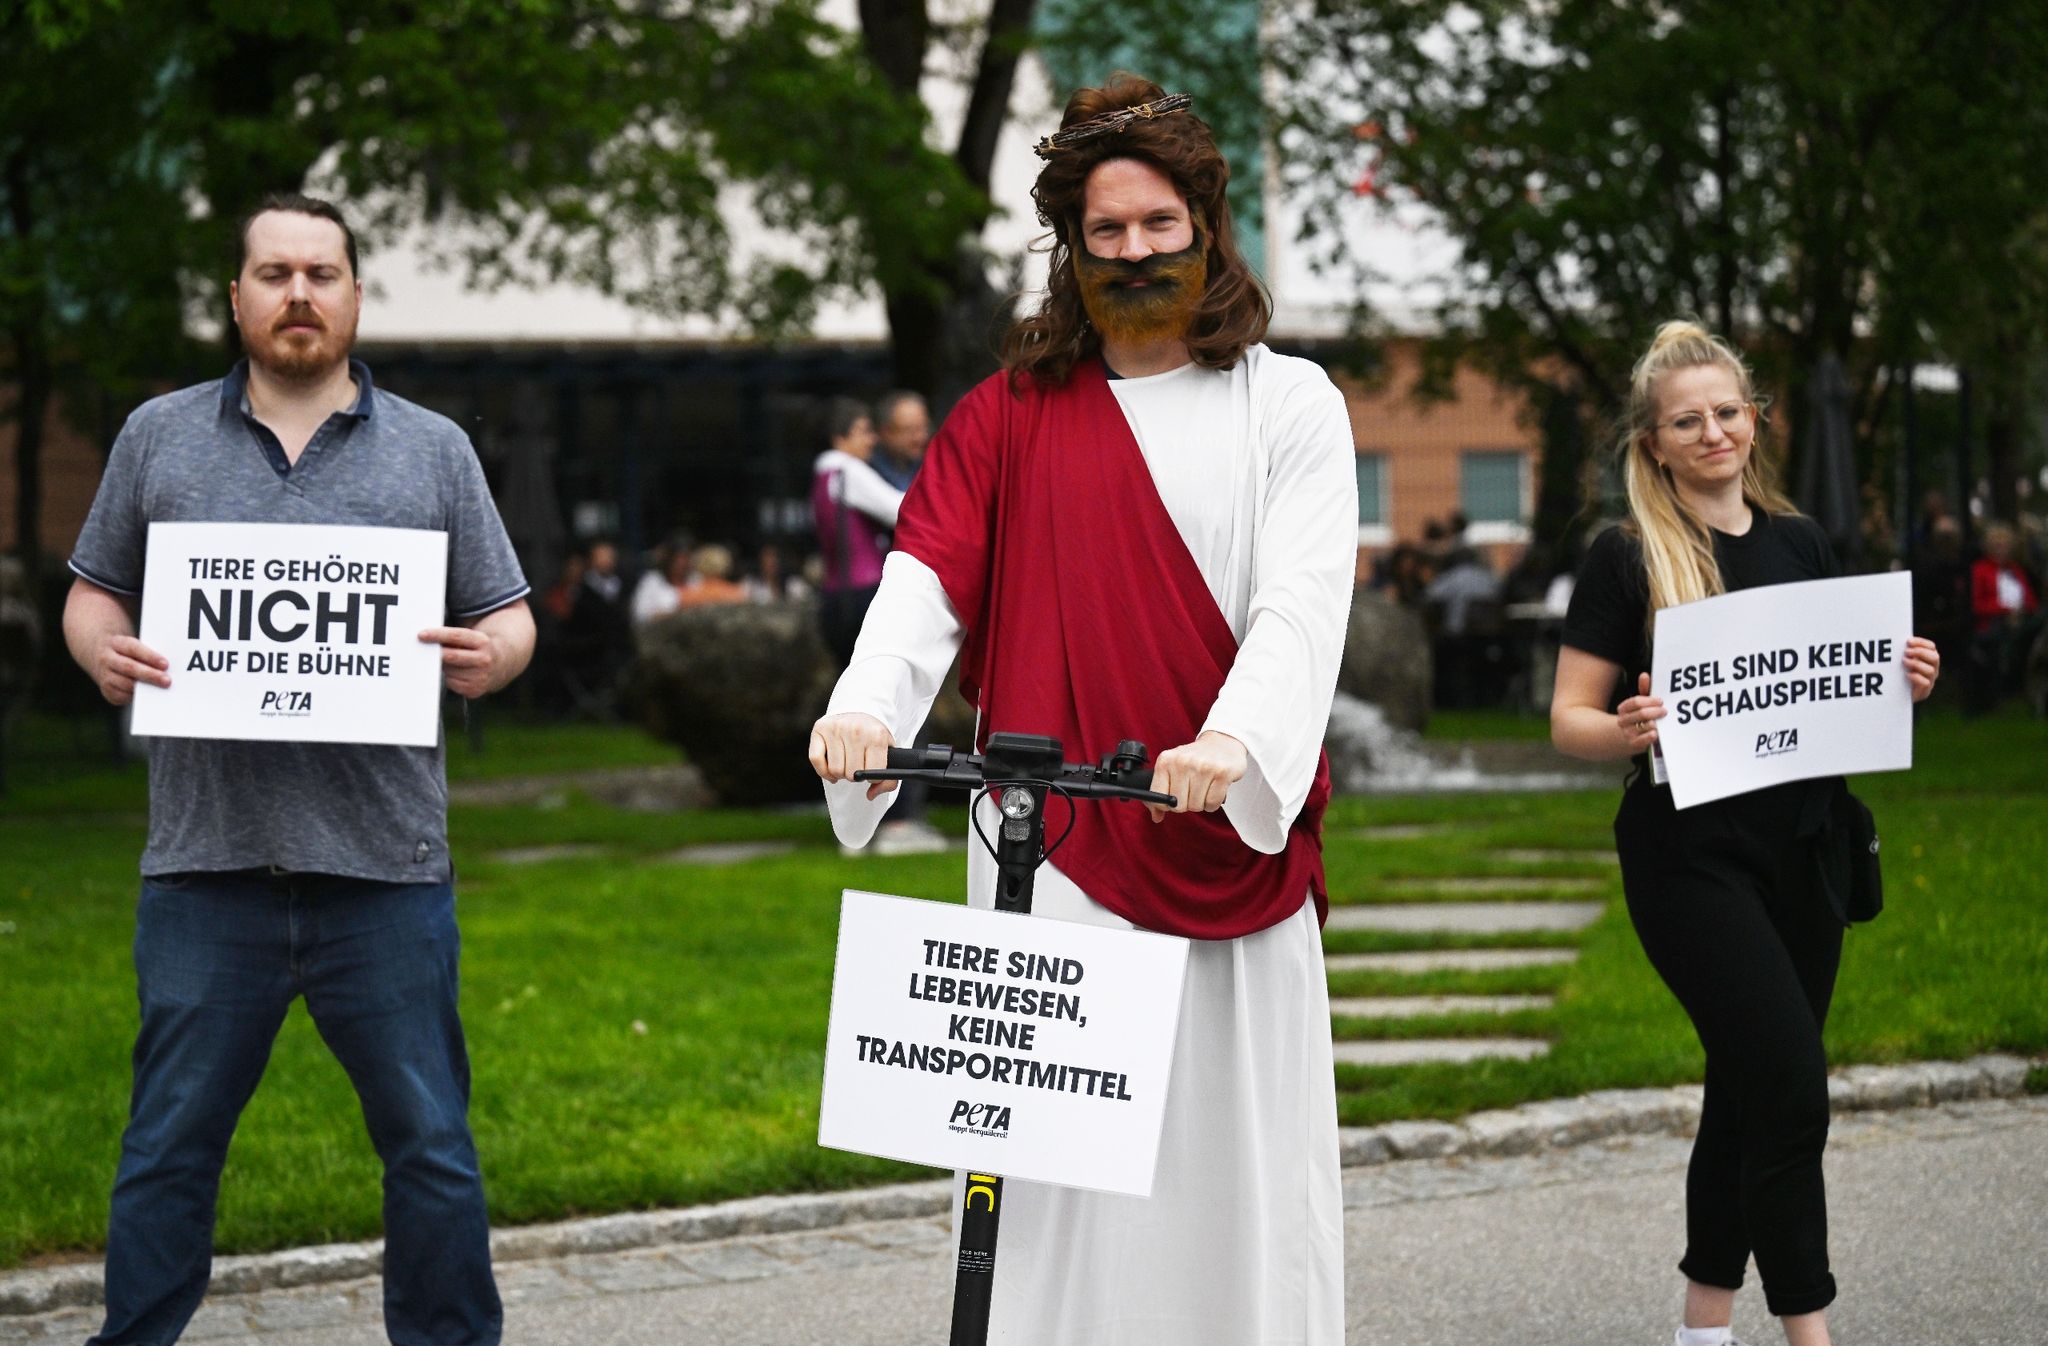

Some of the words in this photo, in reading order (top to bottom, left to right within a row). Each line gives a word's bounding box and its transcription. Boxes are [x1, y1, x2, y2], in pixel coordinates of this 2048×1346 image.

[189, 559, 254, 580] TIERE
[264, 555, 399, 584] GEHÖREN
[188, 589, 398, 645] NICHT
[187, 651, 238, 672] AUF
[248, 652, 288, 673] DIE
[298, 647, 390, 676] BÜHNE
[1670, 661, 1725, 693] ESEL
[1733, 649, 1798, 680] SIND
[1809, 639, 1891, 669] KEINE
[1677, 673, 1883, 724] SCHAUSPIELER
[924, 939, 999, 974] TIERE
[1007, 952, 1083, 985] SIND
[909, 973, 1086, 1027] LEBEWESEN,
[949, 1014, 1035, 1050] KEINE
[857, 1035, 1131, 1101] TRANSPORTMITTEL
